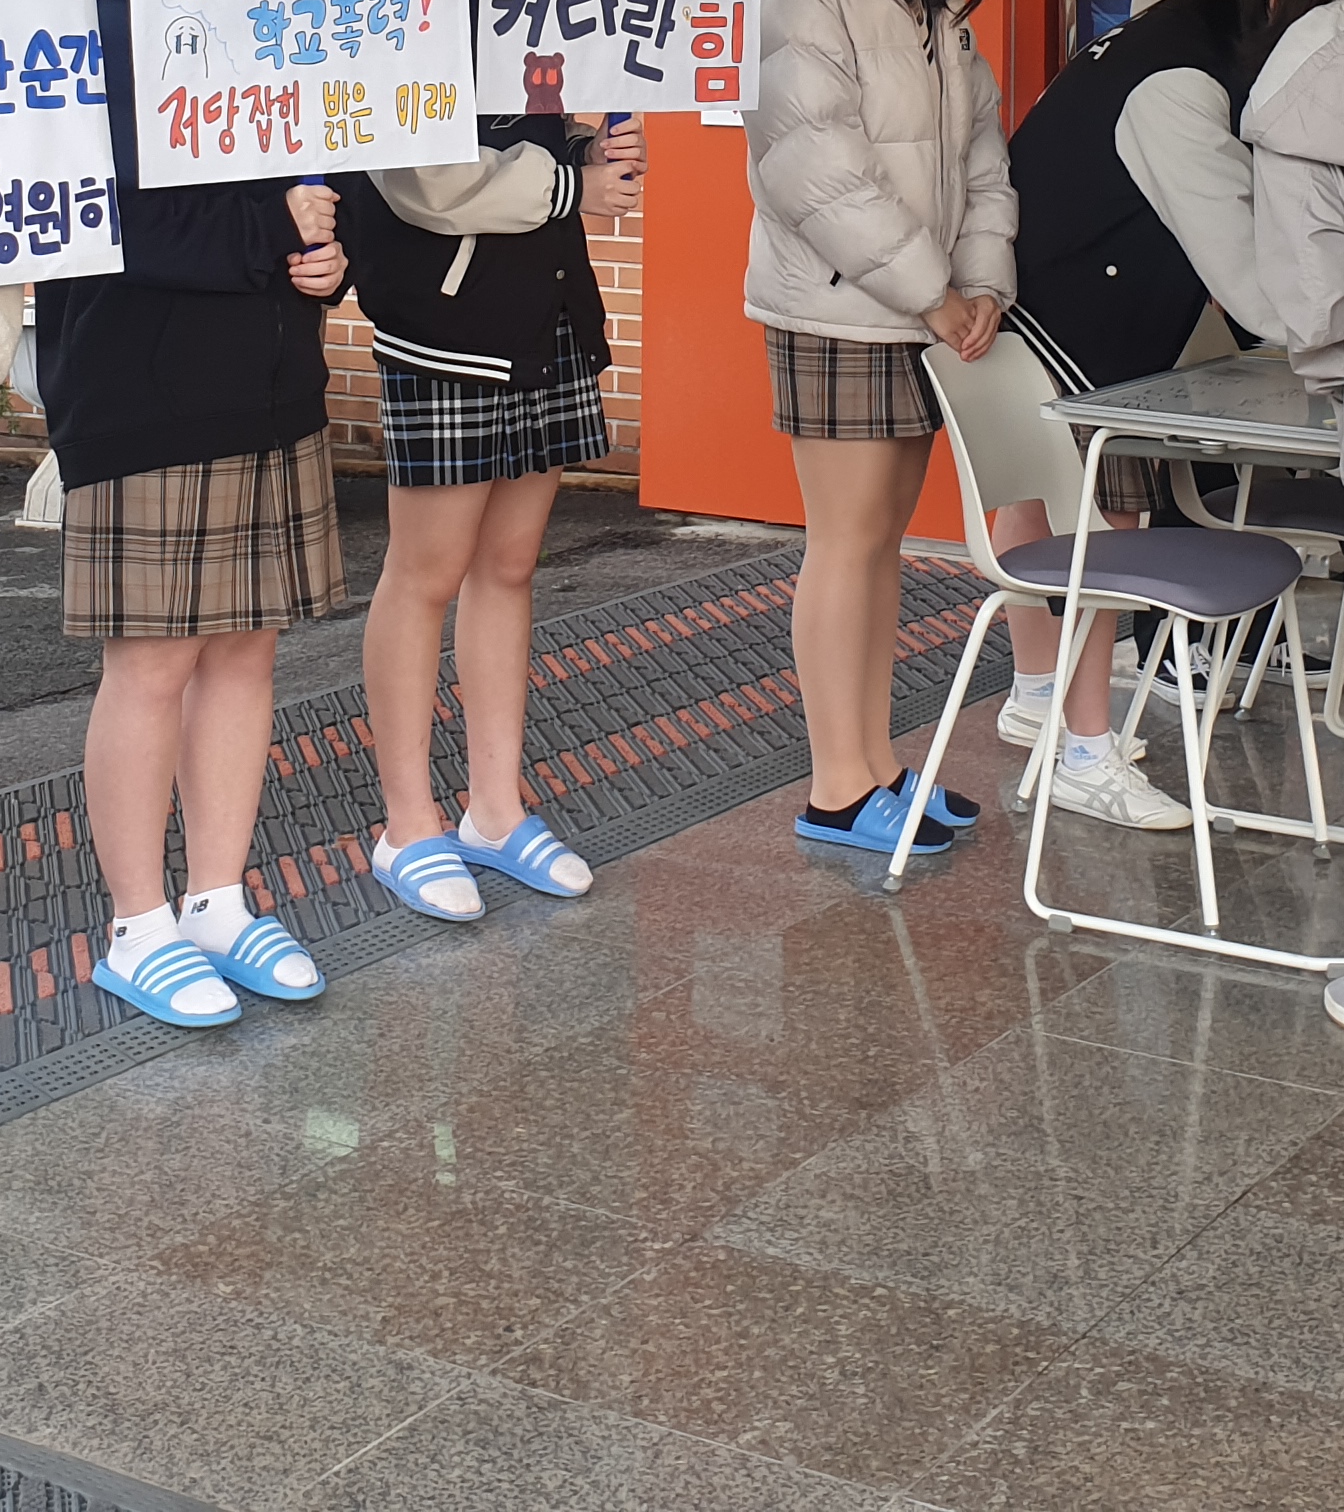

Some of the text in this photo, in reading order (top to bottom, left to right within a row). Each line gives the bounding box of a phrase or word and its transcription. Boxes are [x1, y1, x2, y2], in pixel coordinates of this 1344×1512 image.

[690, 2, 744, 103] 힘
[158, 80, 457, 158] 저당잡힌 밝은 미래
